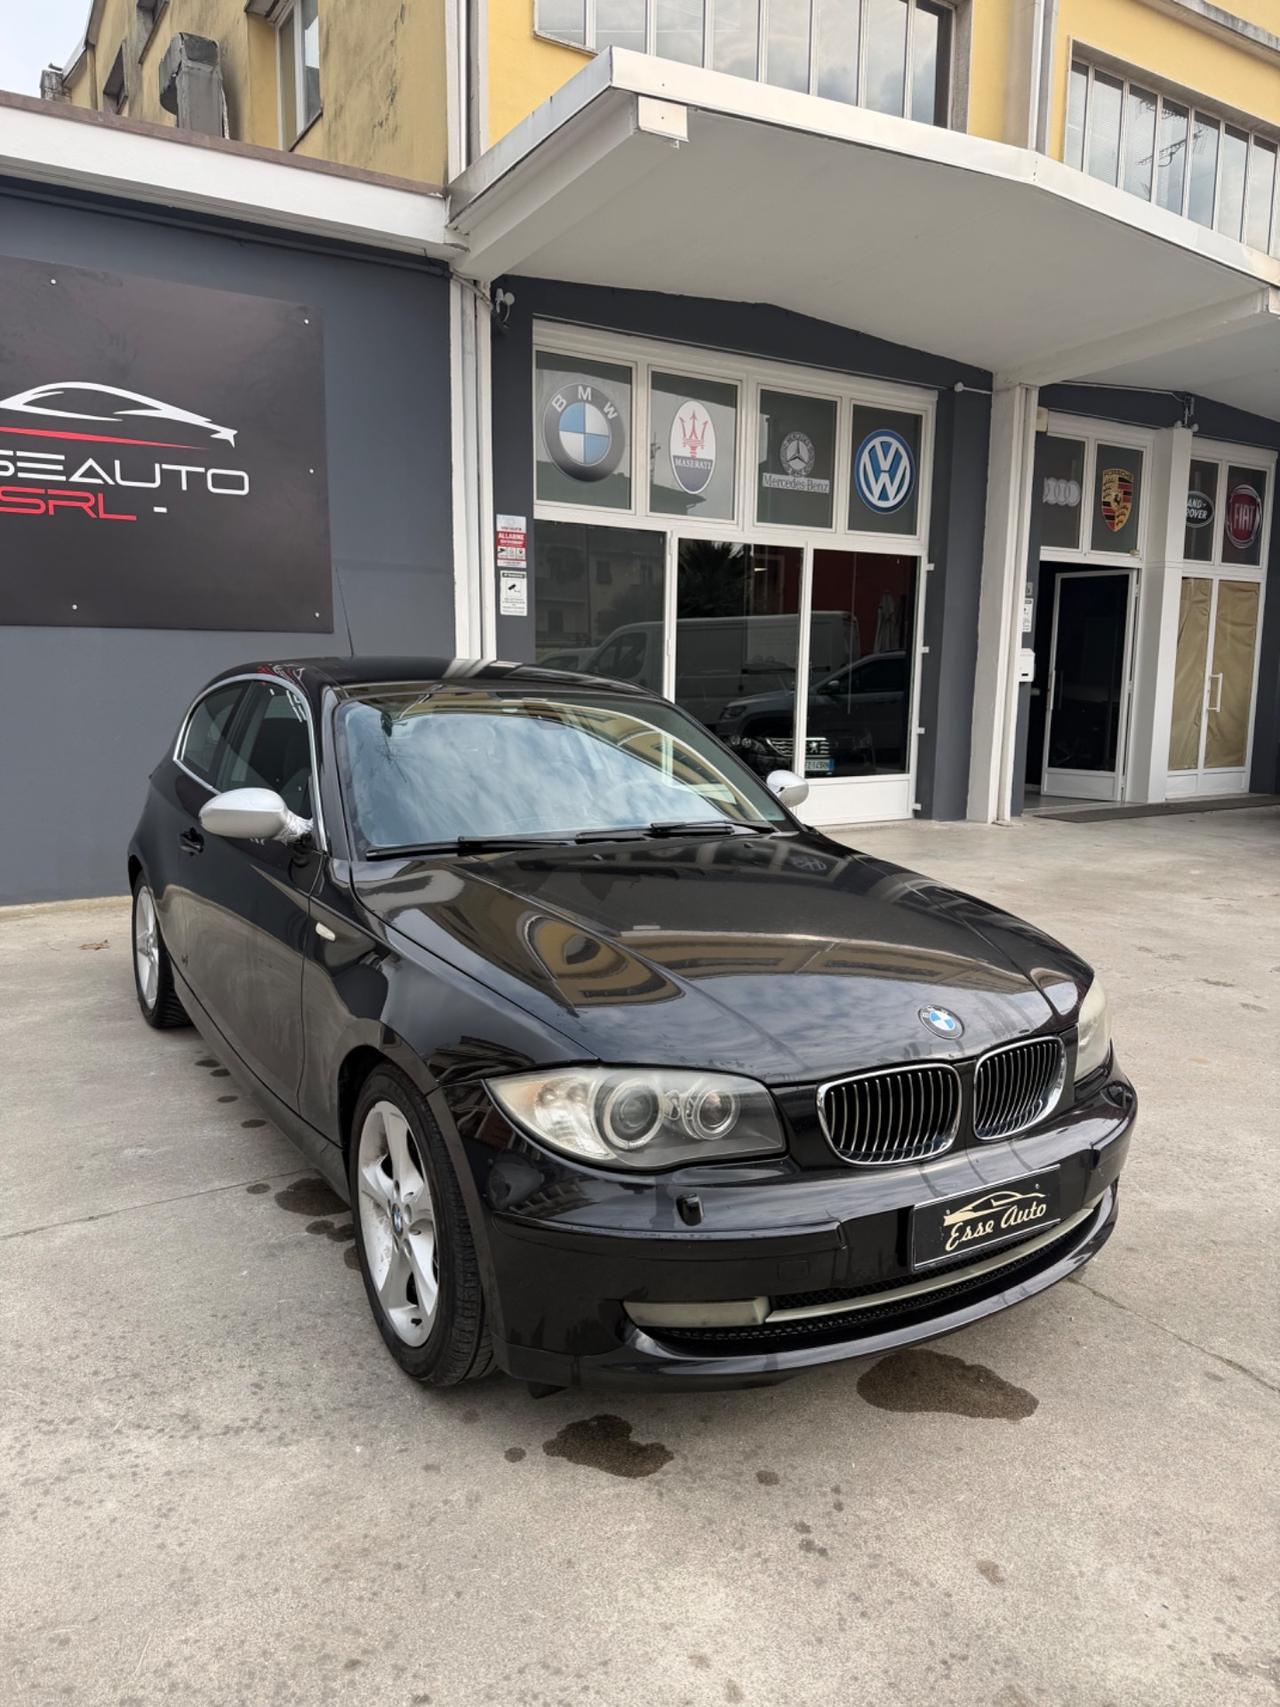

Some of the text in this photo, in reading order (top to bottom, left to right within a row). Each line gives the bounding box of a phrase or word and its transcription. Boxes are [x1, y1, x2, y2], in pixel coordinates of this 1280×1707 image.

[551, 385, 619, 420] BMW
[674, 457, 712, 471] MASERATI
[763, 474, 830, 493] Mercedes-Benz
[0, 486, 137, 521] SRL
[1233, 503, 1255, 530] FIAT
[945, 1201, 1047, 1251] Esse Auto
